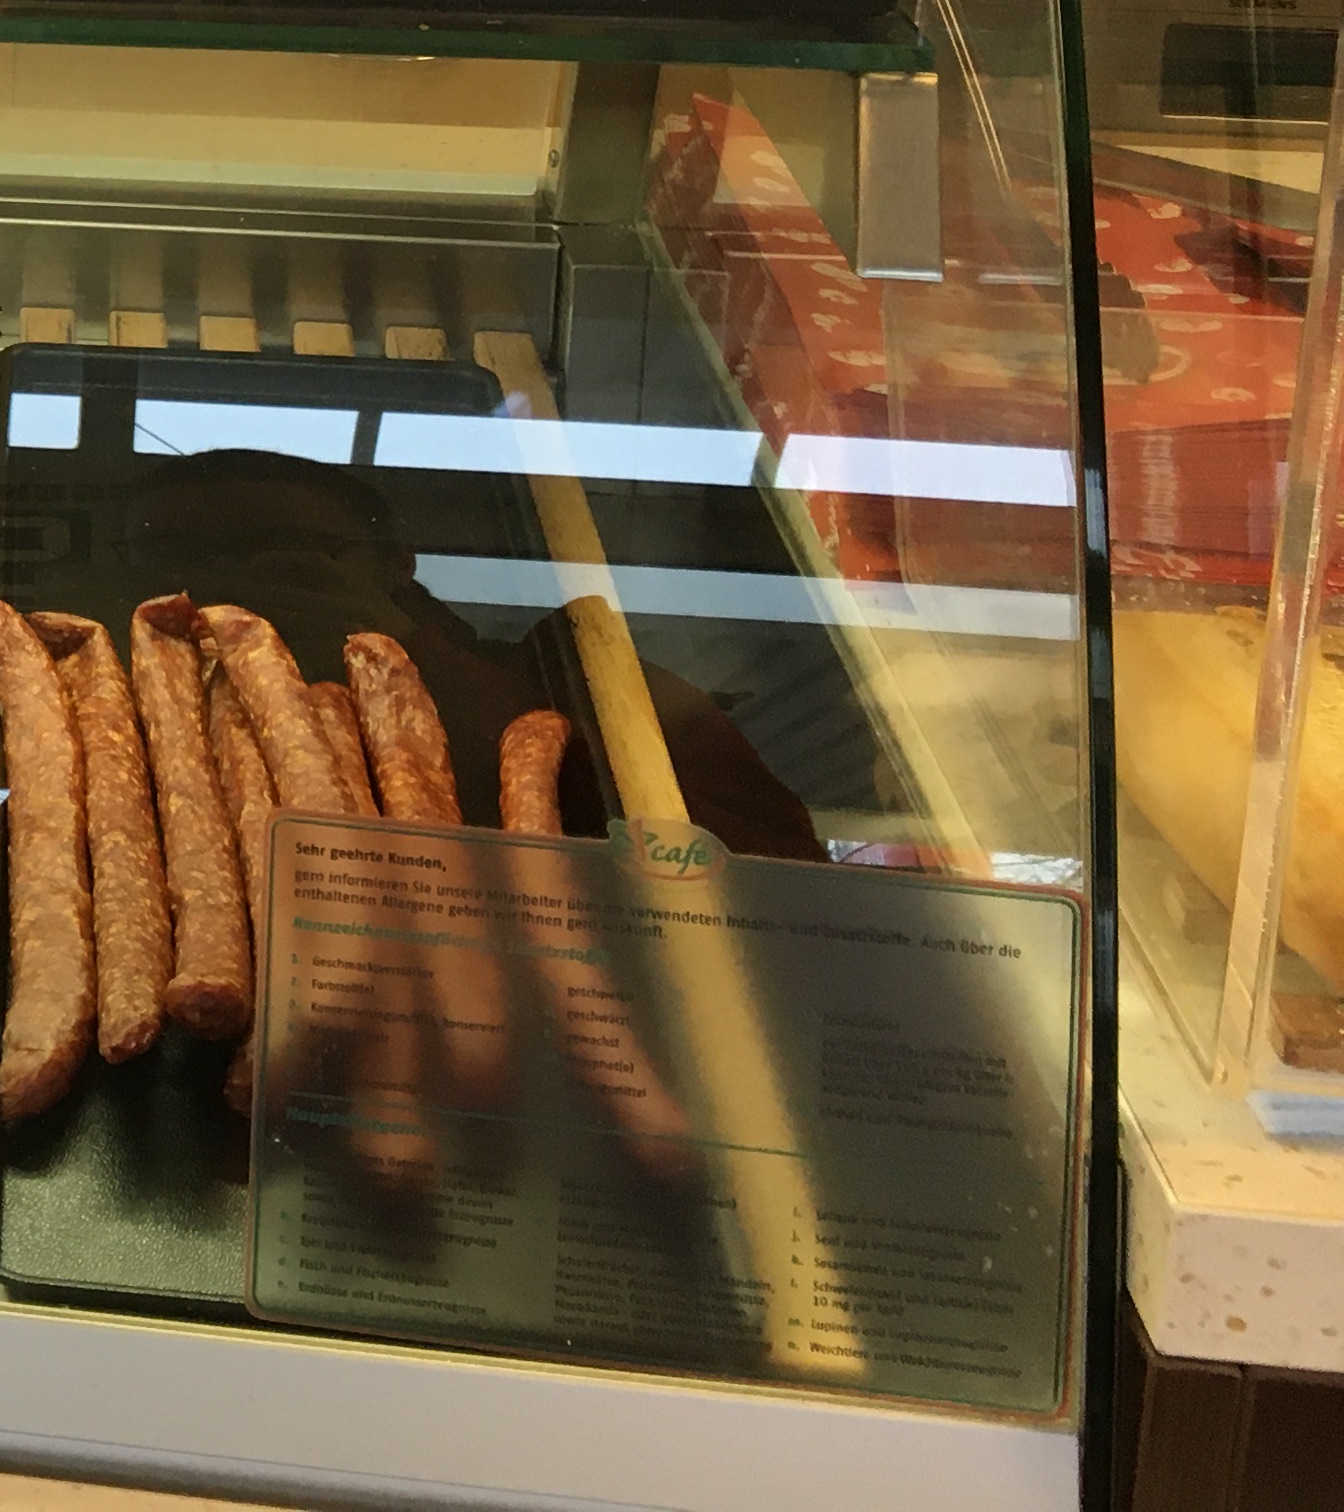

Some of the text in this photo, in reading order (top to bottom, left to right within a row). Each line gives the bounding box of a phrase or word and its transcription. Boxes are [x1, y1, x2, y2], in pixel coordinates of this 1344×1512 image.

[295, 842, 447, 872] Sehr geehrte Kunden,
